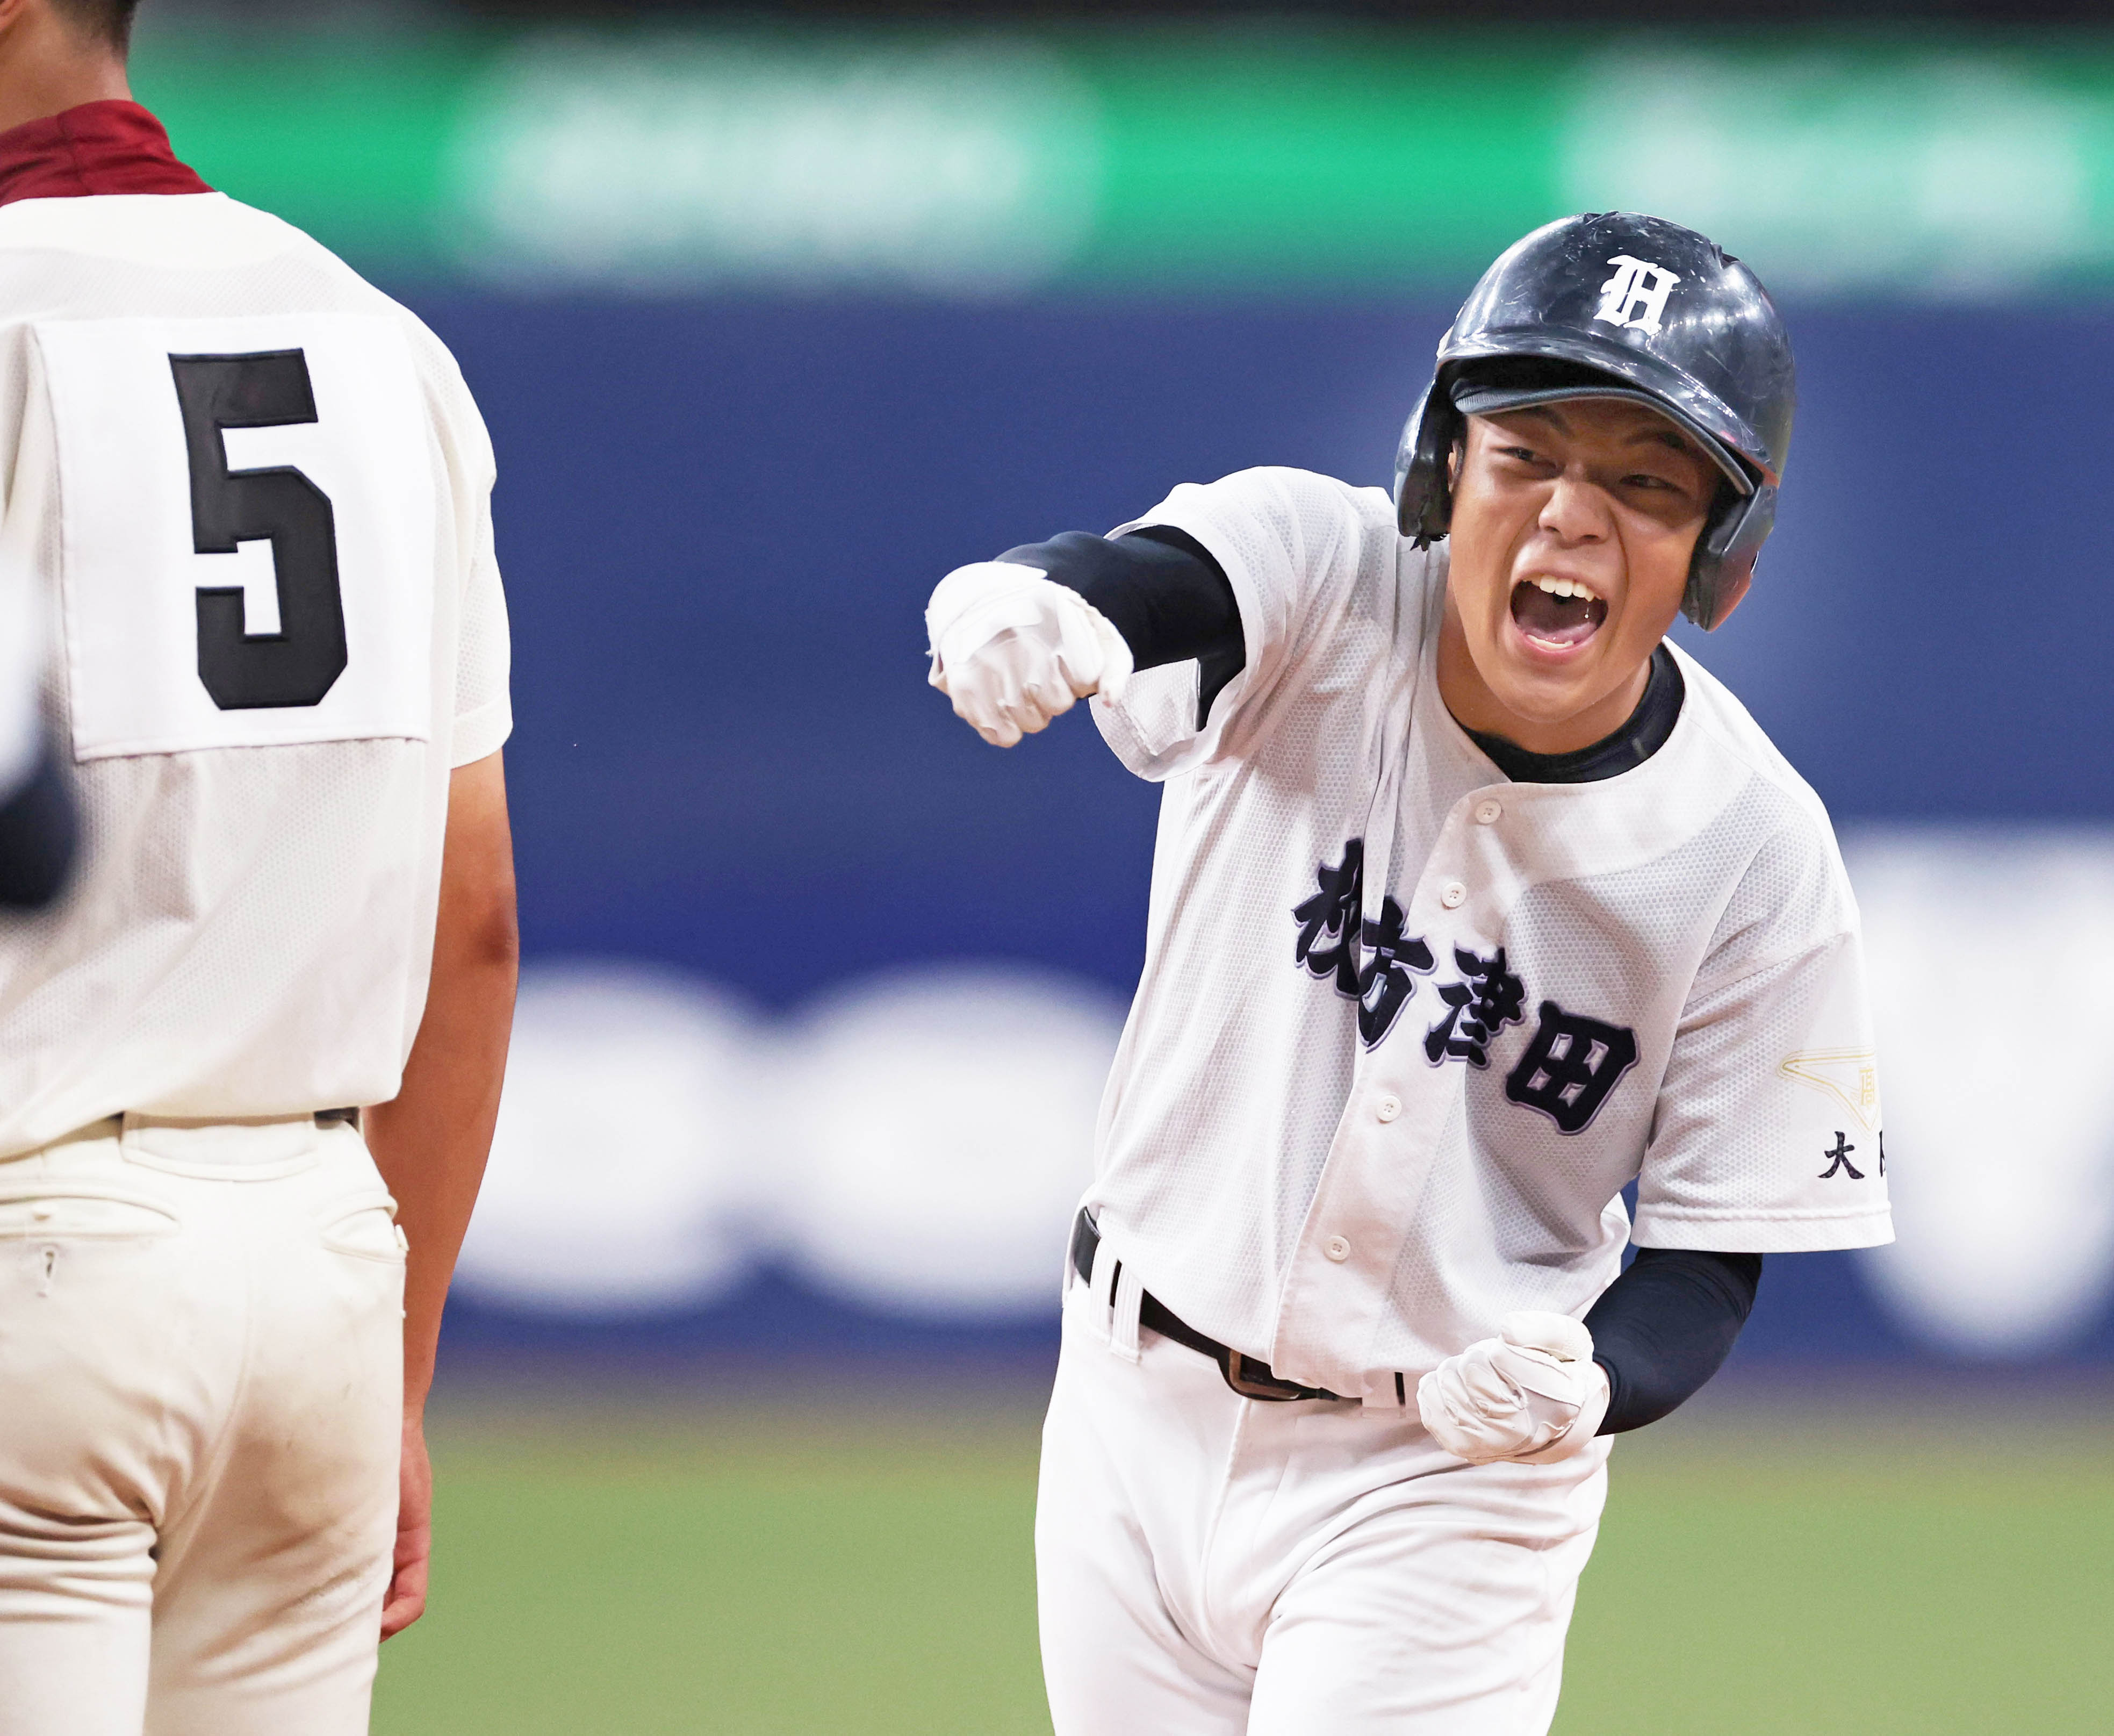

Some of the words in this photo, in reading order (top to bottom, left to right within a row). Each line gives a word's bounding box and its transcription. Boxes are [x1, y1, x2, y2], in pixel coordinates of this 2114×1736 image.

[1593, 255, 1681, 335] H
[168, 348, 348, 710] 5
[1817, 1130, 1885, 1179] 大
